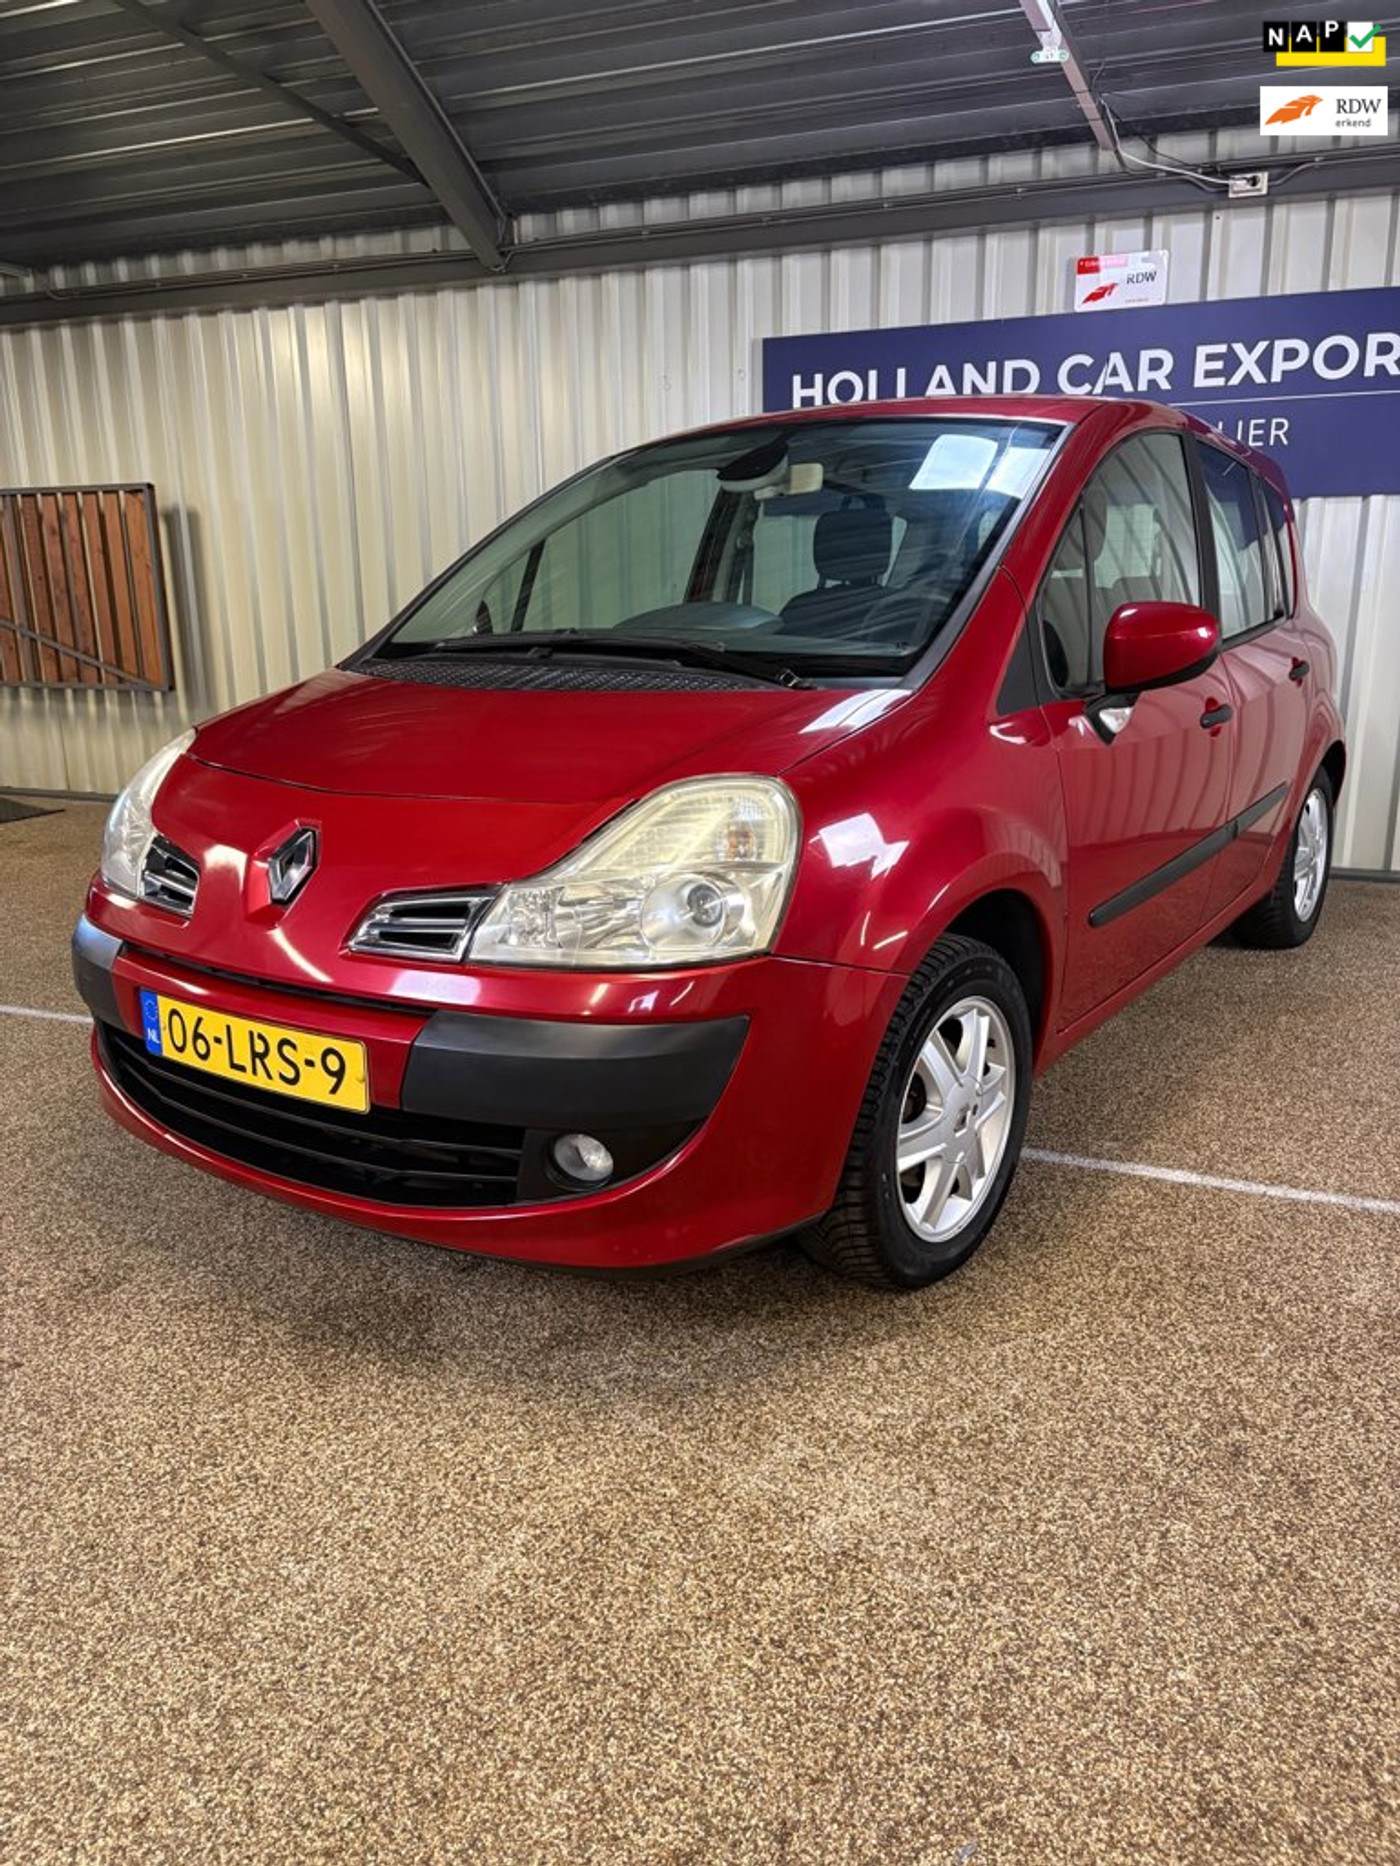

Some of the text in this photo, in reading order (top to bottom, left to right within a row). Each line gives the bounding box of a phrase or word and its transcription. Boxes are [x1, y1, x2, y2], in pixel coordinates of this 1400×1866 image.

[1126, 271, 1157, 284] RDW
[1057, 348, 1172, 395] CAR
[147, 1027, 161, 1044] NL
[167, 1008, 346, 1095] 06-LRS-9
